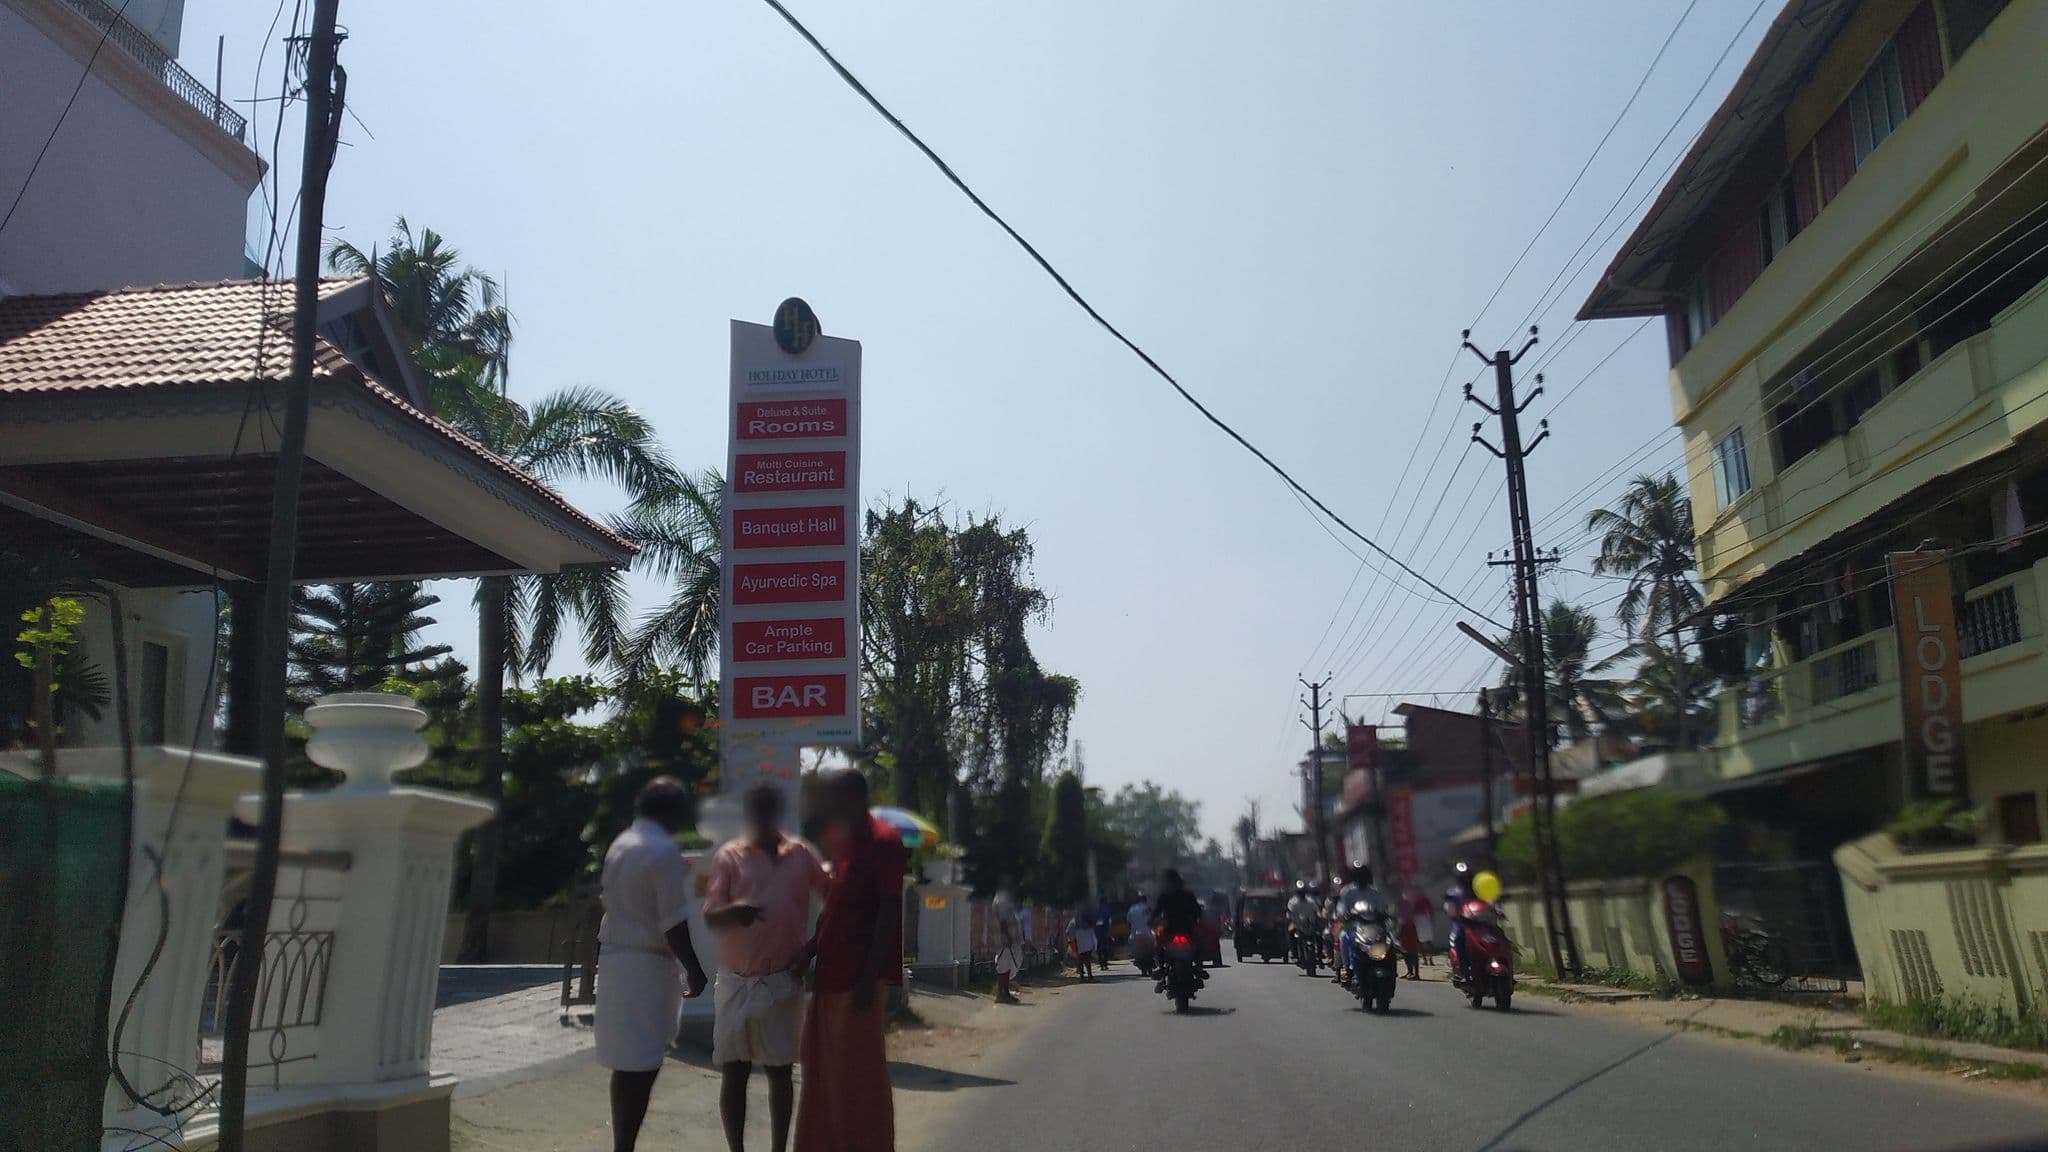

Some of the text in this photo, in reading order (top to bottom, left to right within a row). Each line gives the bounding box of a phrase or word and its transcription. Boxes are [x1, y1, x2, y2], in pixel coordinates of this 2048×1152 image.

[748, 367, 839, 382] HOLIDAY HOTEL
[757, 406, 827, 417] Deluxe & Suite
[748, 420, 835, 434] Rooms
[757, 459, 824, 469] Multi Cuisine
[744, 468, 835, 485] Restaurant
[742, 517, 836, 537] Banquet Hall
[741, 573, 837, 593] Ayurvedic Spa
[765, 624, 813, 639] Ample
[746, 640, 833, 654] Car Parking
[751, 684, 827, 709] BAR
[1914, 595, 1954, 793] LODGE
